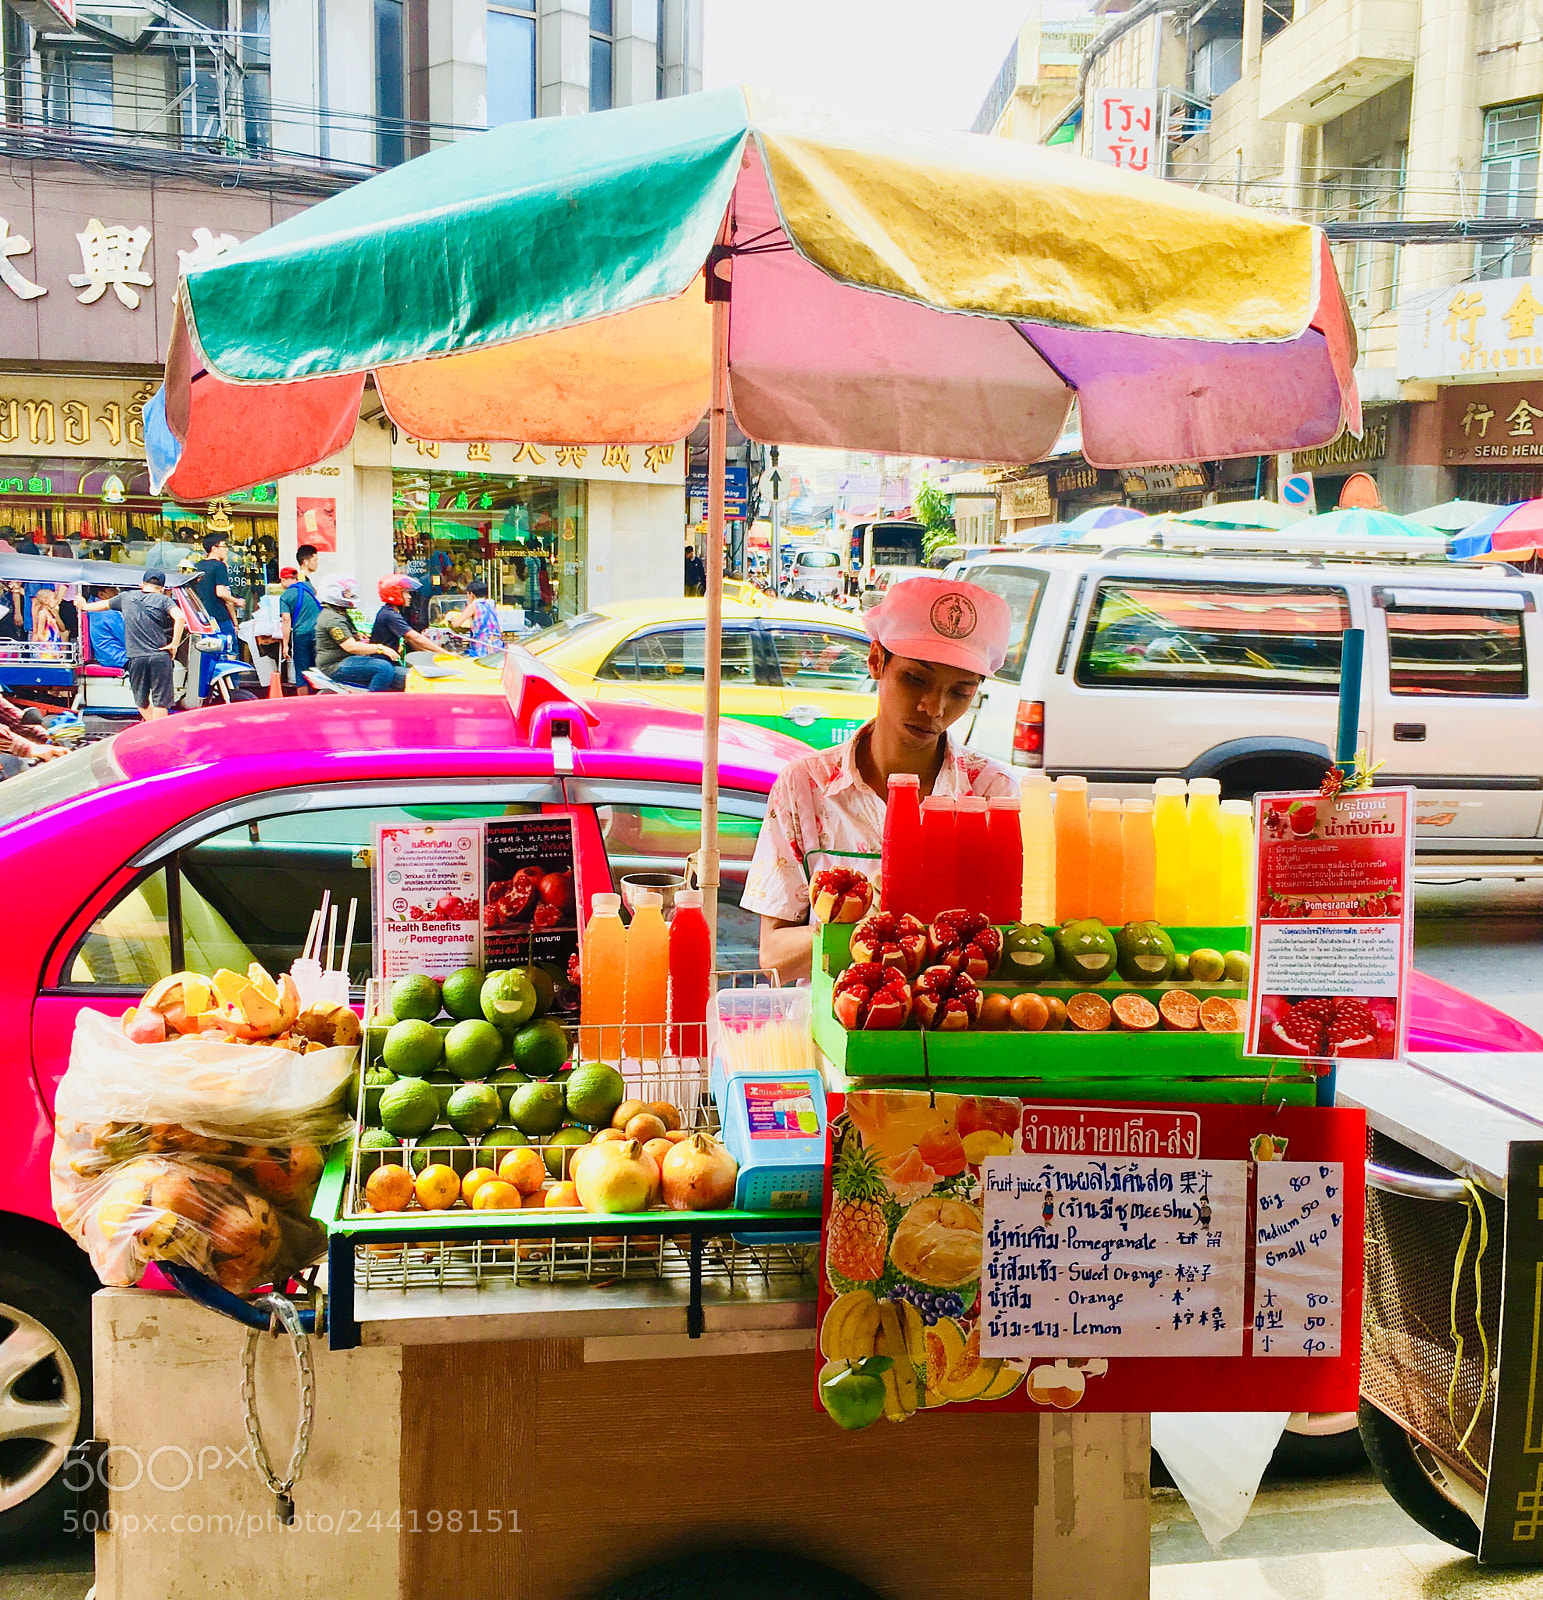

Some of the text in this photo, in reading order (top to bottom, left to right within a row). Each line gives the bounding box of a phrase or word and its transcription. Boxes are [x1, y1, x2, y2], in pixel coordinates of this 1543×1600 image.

[1103, 98, 1151, 132] โรง
[1474, 445, 1508, 457] SENG
[1324, 816, 1395, 837] น้ำทับทิม
[1348, 810, 1371, 819] ของ
[1305, 900, 1359, 910] Pomegranate
[388, 922, 461, 932] Health Benefits
[398, 935, 409, 945] of
[410, 934, 474, 944] Pomegranate
[1024, 1114, 1195, 1155] จำหน่ายปลีก-ส่ง
[987, 1169, 1013, 1191] Fruit
[1015, 1173, 1042, 1199] juice
[1179, 1169, 1213, 1198] 果汁
[1260, 1193, 1285, 1212] Big
[1290, 1175, 1312, 1192] 80
[1258, 1217, 1300, 1244] Medium
[1300, 1199, 1320, 1219] 50
[1067, 1226, 1157, 1260] Pomegranate
[1265, 1240, 1307, 1266] Small
[1309, 1229, 1328, 1247] 40
[1068, 1262, 1109, 1281] Sweet
[1114, 1269, 1163, 1288] Orange
[987, 1280, 1032, 1309] น้ำส้ม
[1068, 1290, 1124, 1310] Orange
[1072, 1311, 1122, 1335] Lemon
